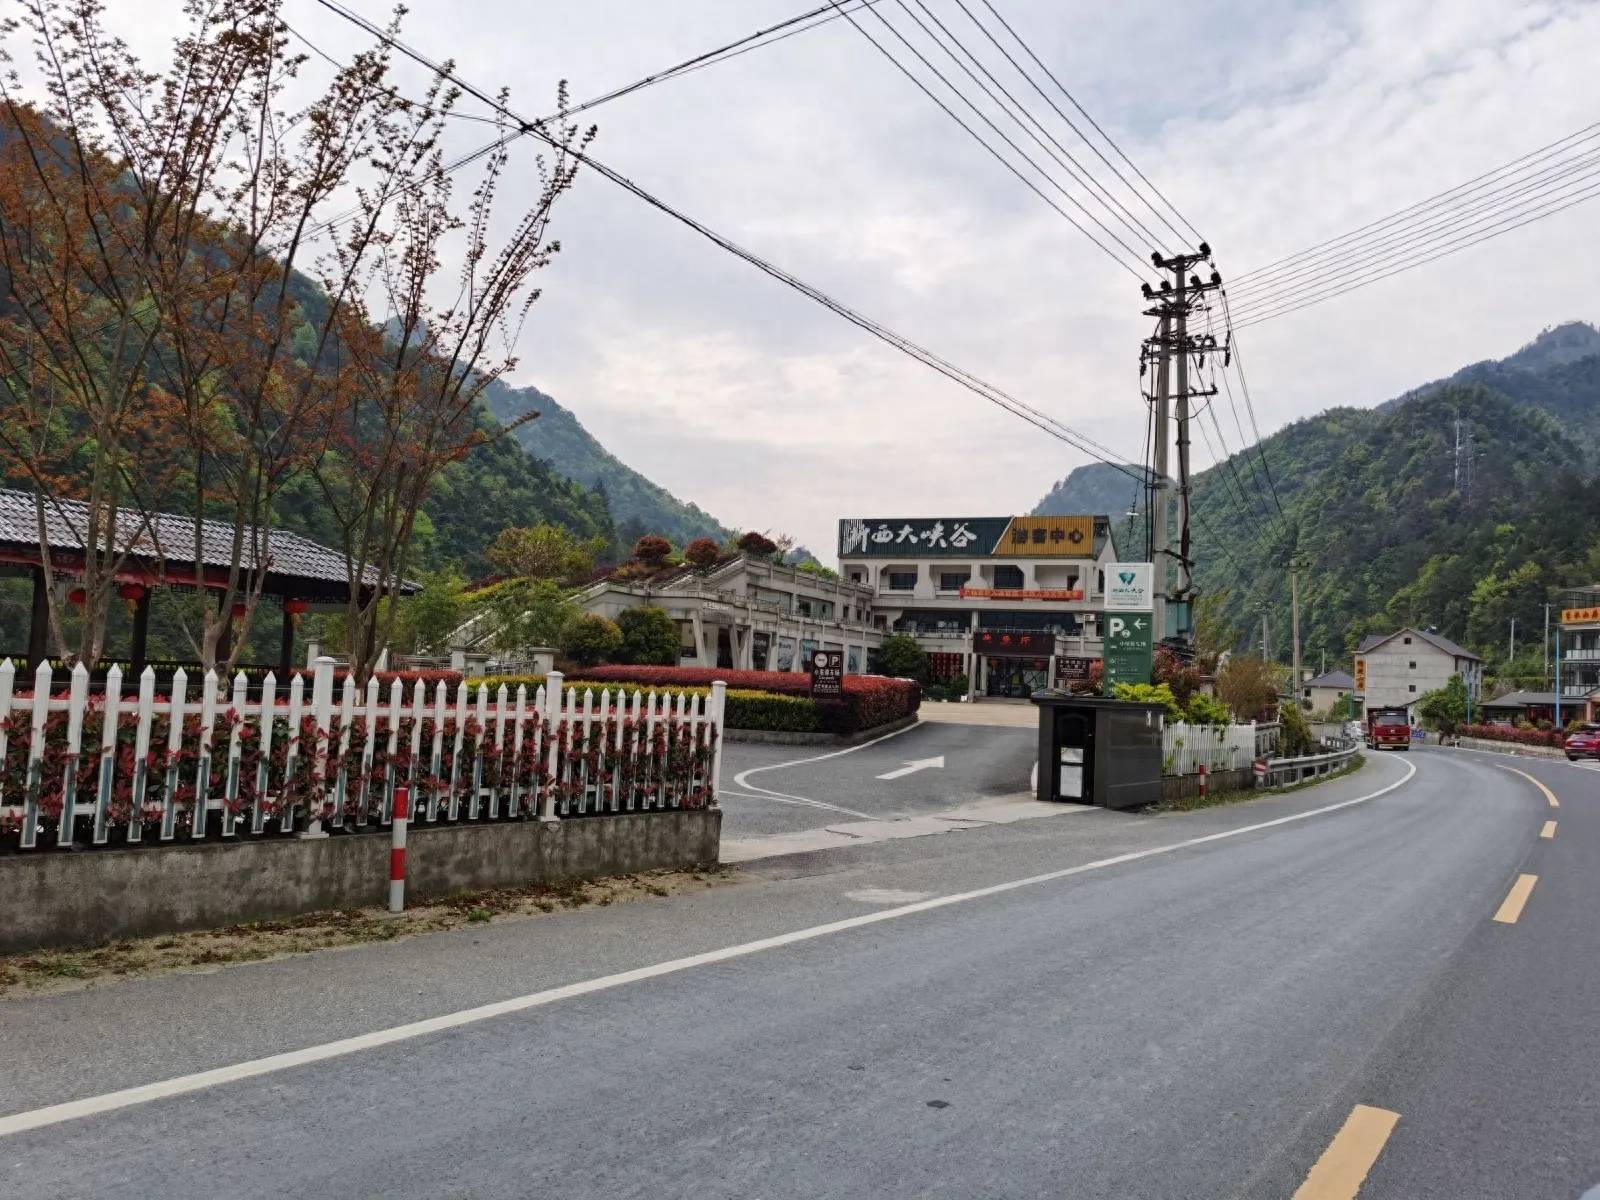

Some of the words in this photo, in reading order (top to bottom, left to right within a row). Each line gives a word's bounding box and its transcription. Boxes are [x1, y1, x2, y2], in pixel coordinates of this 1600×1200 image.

[845, 520, 978, 553] 浙西大峡谷
[1011, 527, 1084, 545] 游客中心
[1109, 617, 1125, 638] P
[831, 656, 839, 666] P
